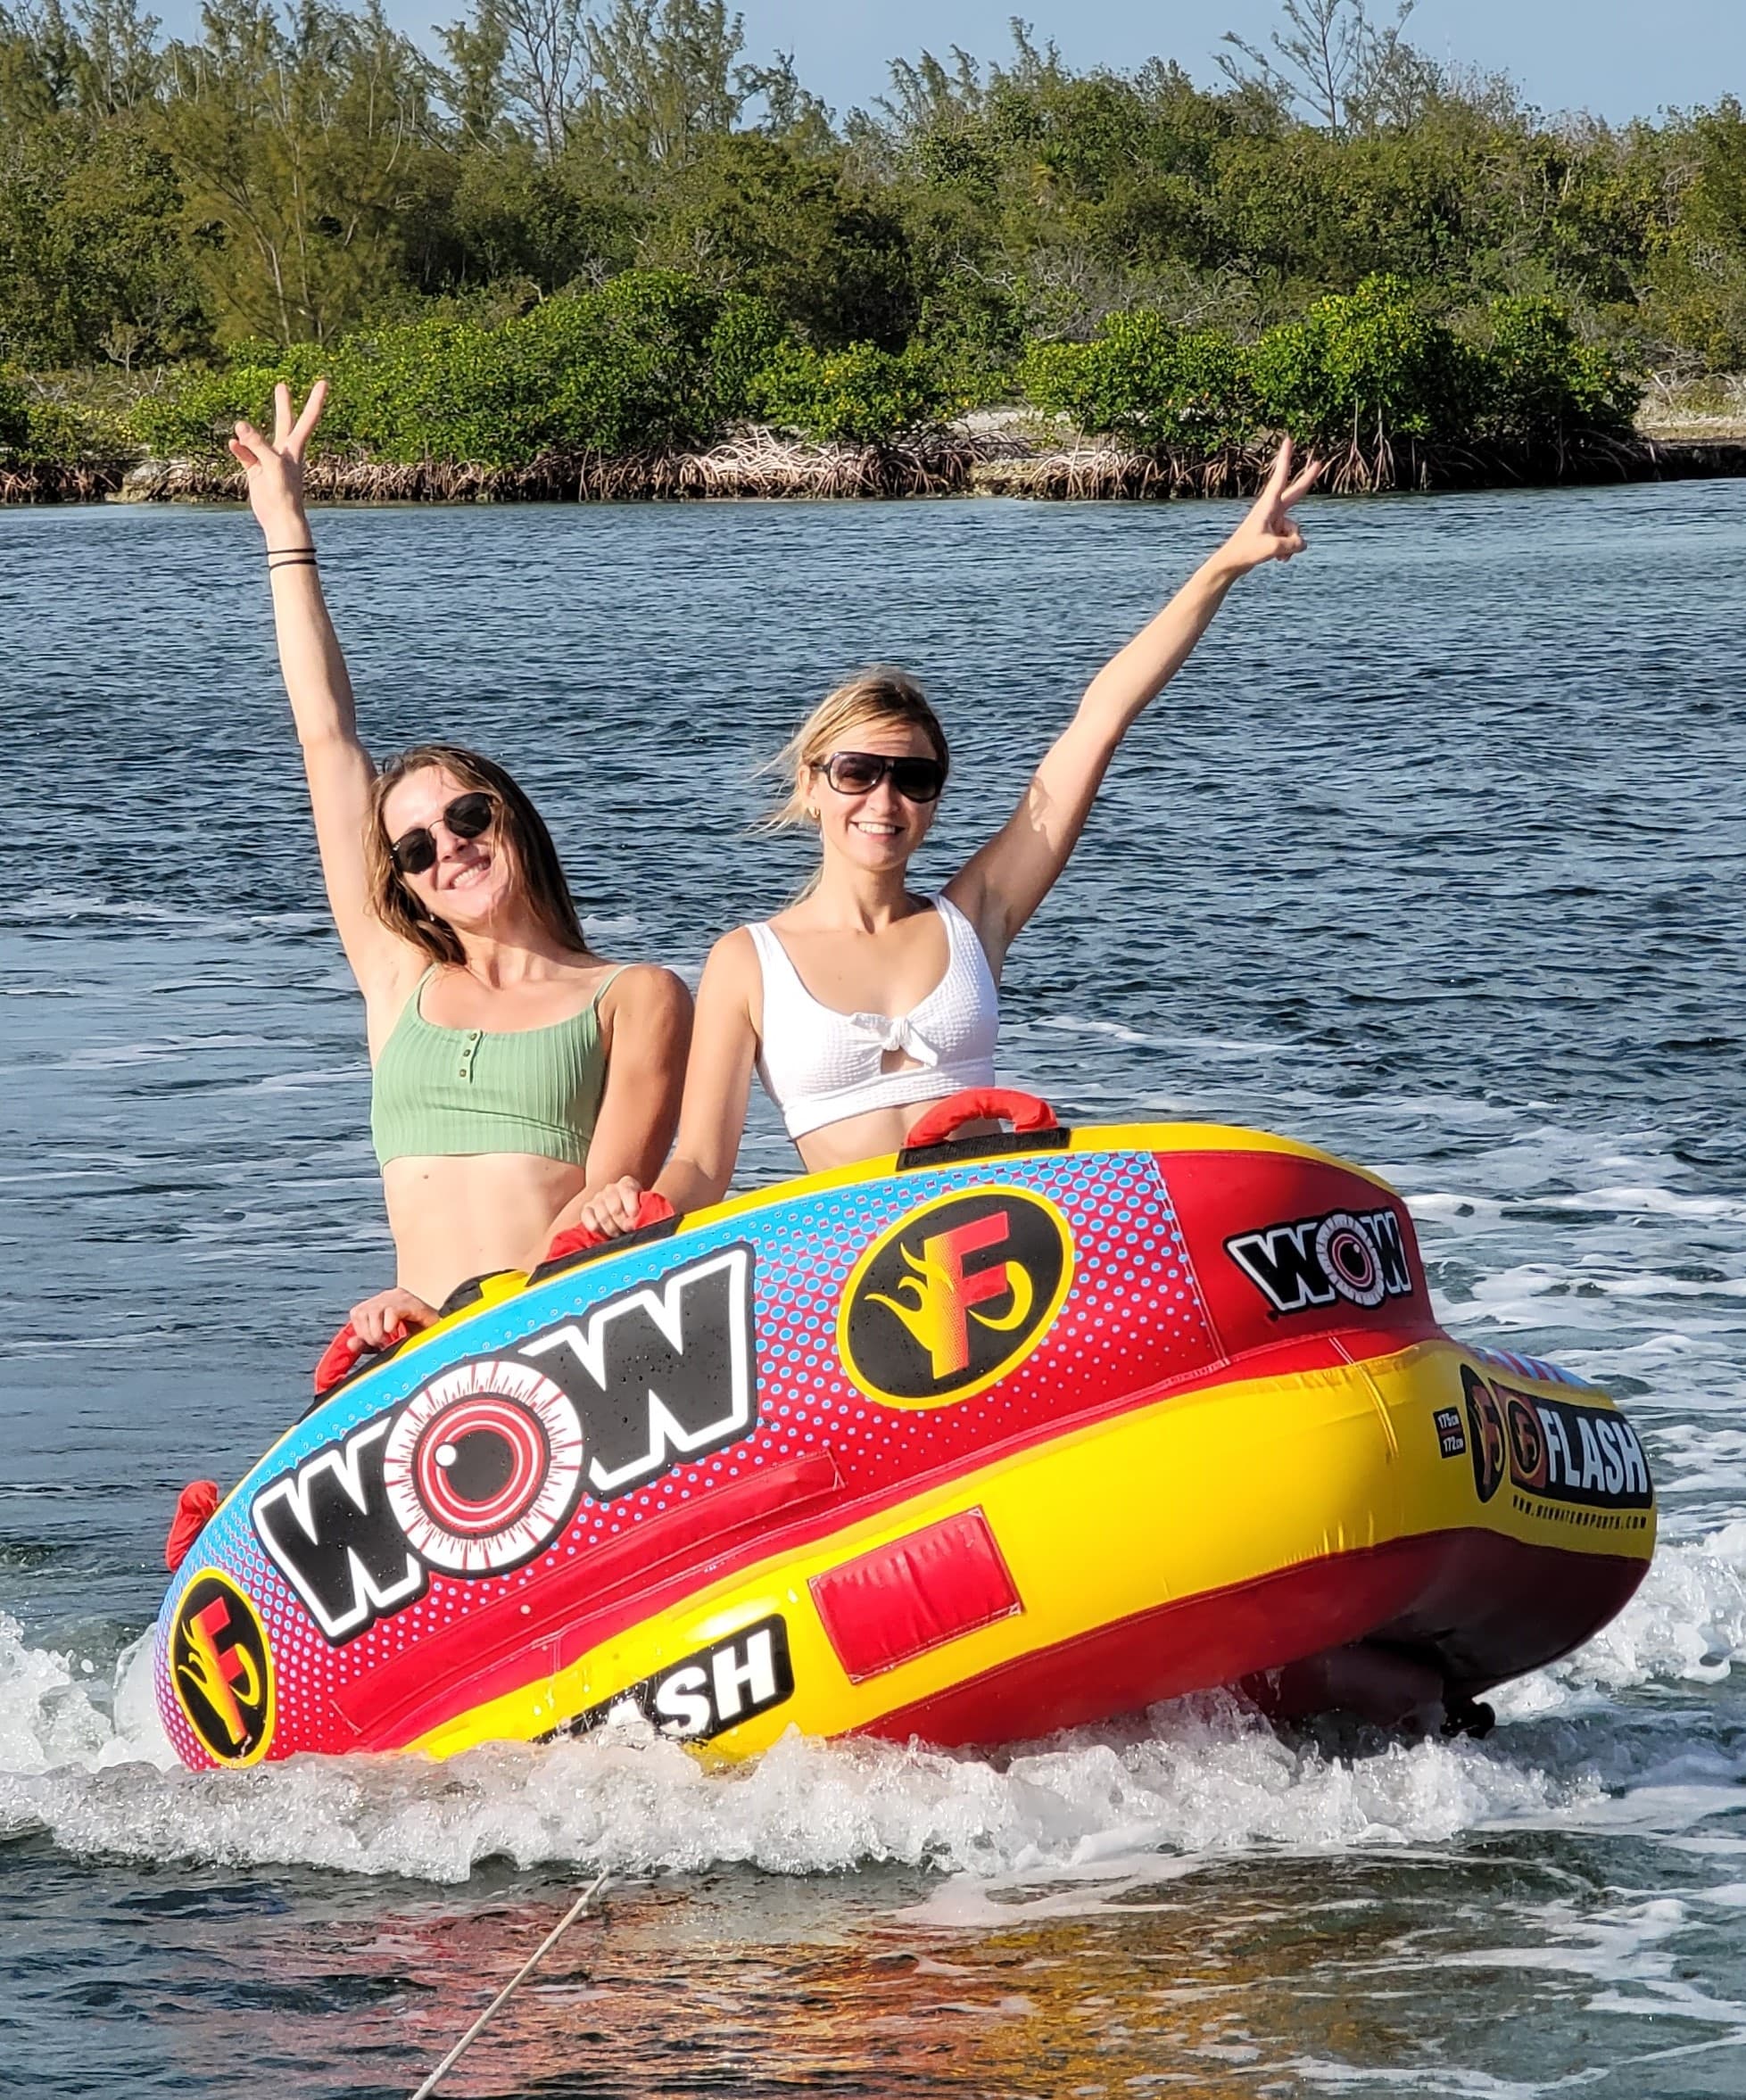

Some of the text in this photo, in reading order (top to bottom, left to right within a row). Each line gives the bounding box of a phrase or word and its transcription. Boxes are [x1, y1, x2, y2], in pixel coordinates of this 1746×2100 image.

[1227, 1211, 1411, 1310] WOW
[253, 1247, 749, 1639] WOW
[1536, 1407, 1648, 1494] FLASH
[178, 1596, 260, 1745] F
